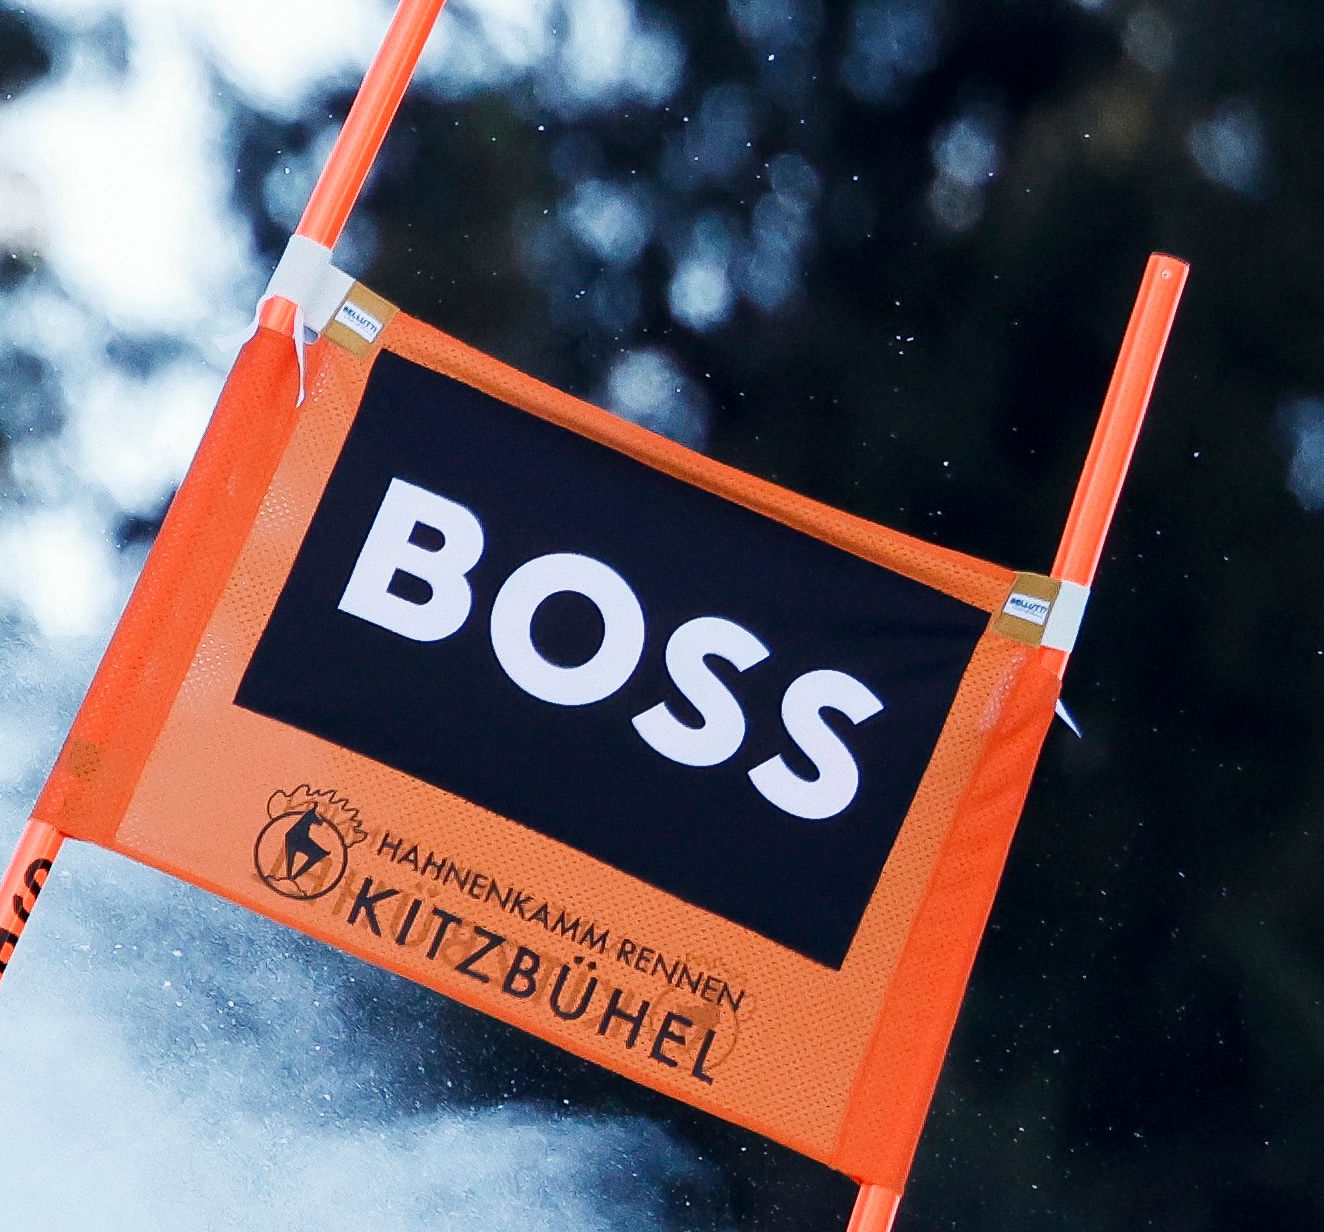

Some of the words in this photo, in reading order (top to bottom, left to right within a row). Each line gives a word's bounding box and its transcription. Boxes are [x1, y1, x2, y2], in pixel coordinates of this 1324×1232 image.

[337, 476, 884, 820] BOSS
[347, 876, 718, 1087] KITZBÜHEL
[377, 831, 610, 954] HAHNENKAMM
[615, 938, 746, 1012] RENNEN
